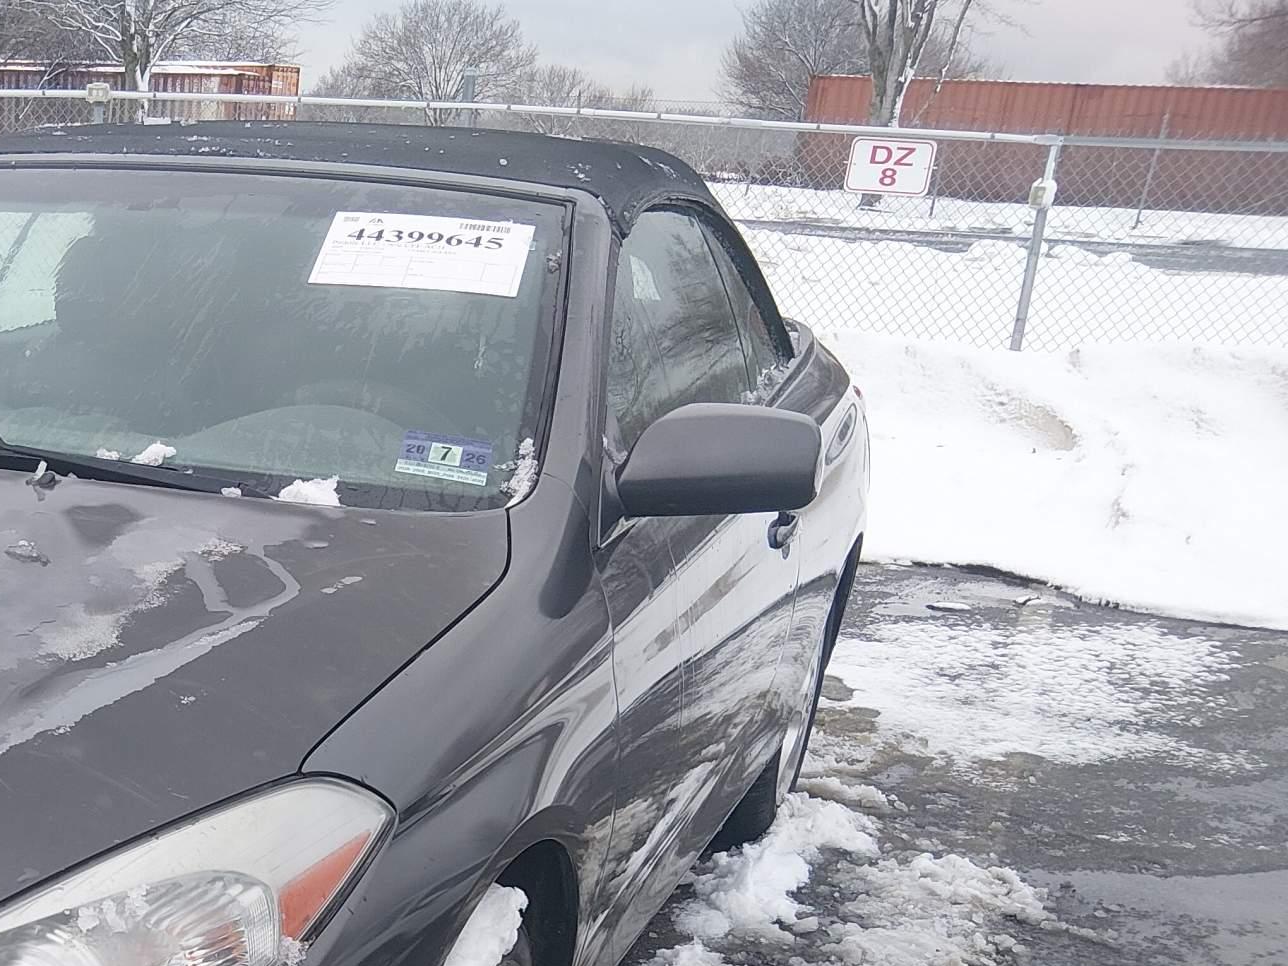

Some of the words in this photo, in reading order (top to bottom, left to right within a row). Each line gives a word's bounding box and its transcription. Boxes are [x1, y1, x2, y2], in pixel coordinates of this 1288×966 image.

[869, 145, 916, 167] DZ
[878, 168, 897, 187] 8
[346, 227, 505, 250] 44399645
[405, 443, 426, 455] 20
[440, 445, 453, 461] 7
[464, 452, 487, 465] 26
